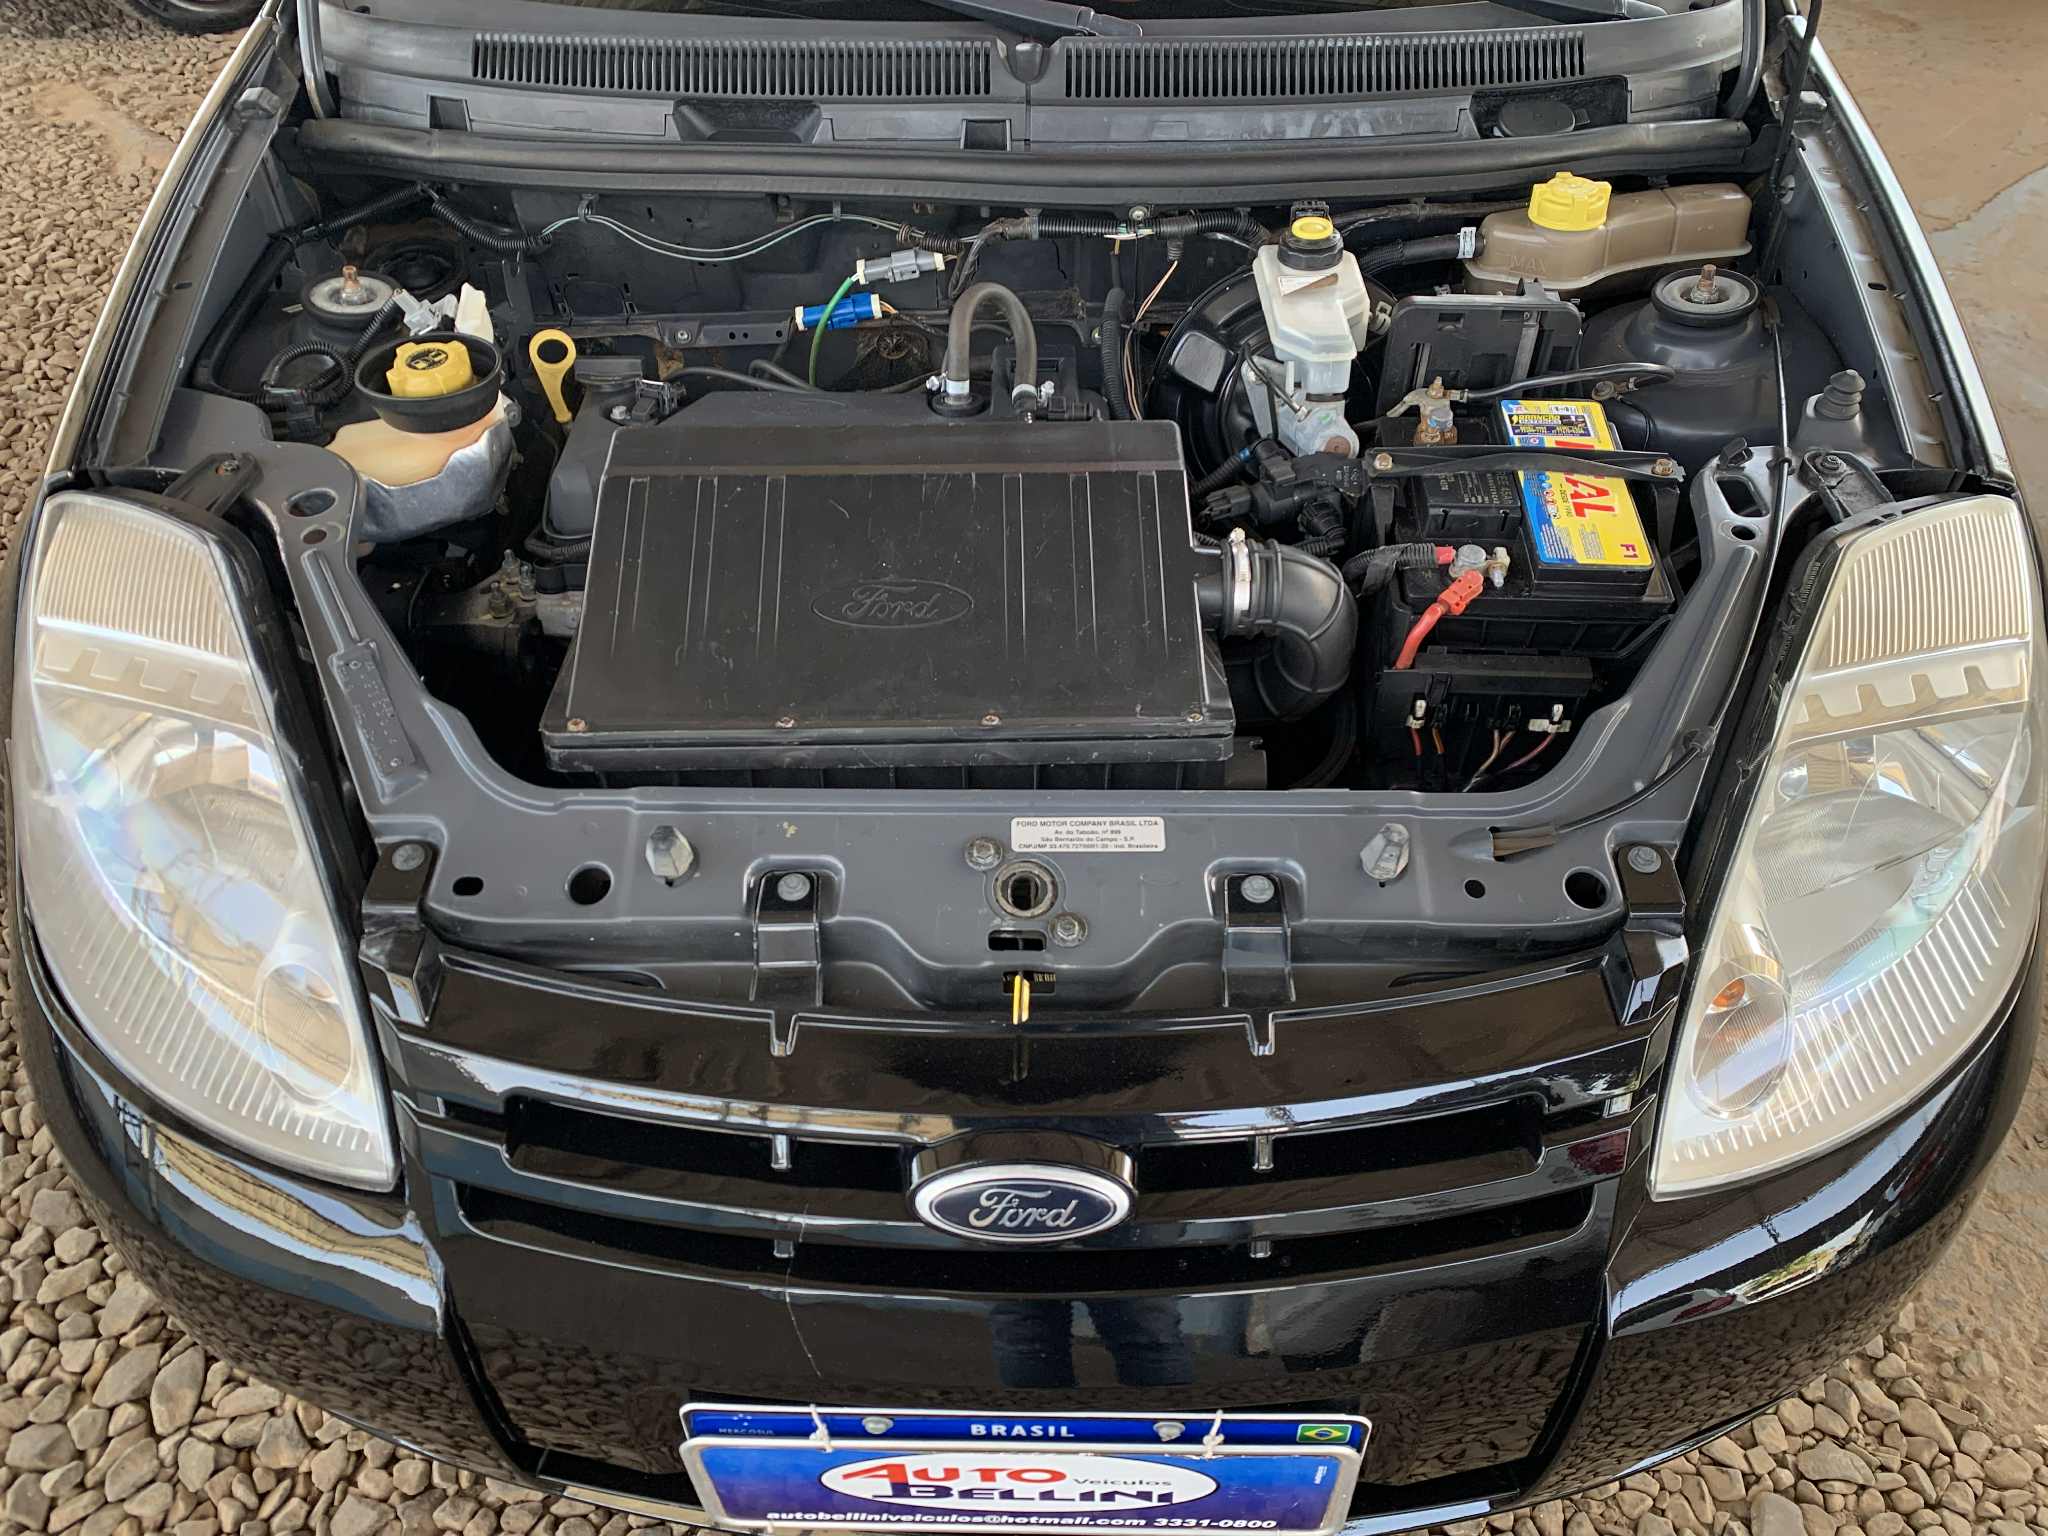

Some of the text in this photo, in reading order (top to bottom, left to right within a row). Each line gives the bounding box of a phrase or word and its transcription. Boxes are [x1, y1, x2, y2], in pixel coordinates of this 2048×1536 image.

[1620, 543, 1639, 559] F1
[842, 584, 941, 619] Ford
[968, 1188, 1079, 1228] Ford
[970, 1423, 1075, 1437] BRASIL
[841, 1463, 1067, 1484] AUTO
[872, 1482, 1174, 1504] BELLINI
[1153, 1517, 1277, 1529] 3331-0800
